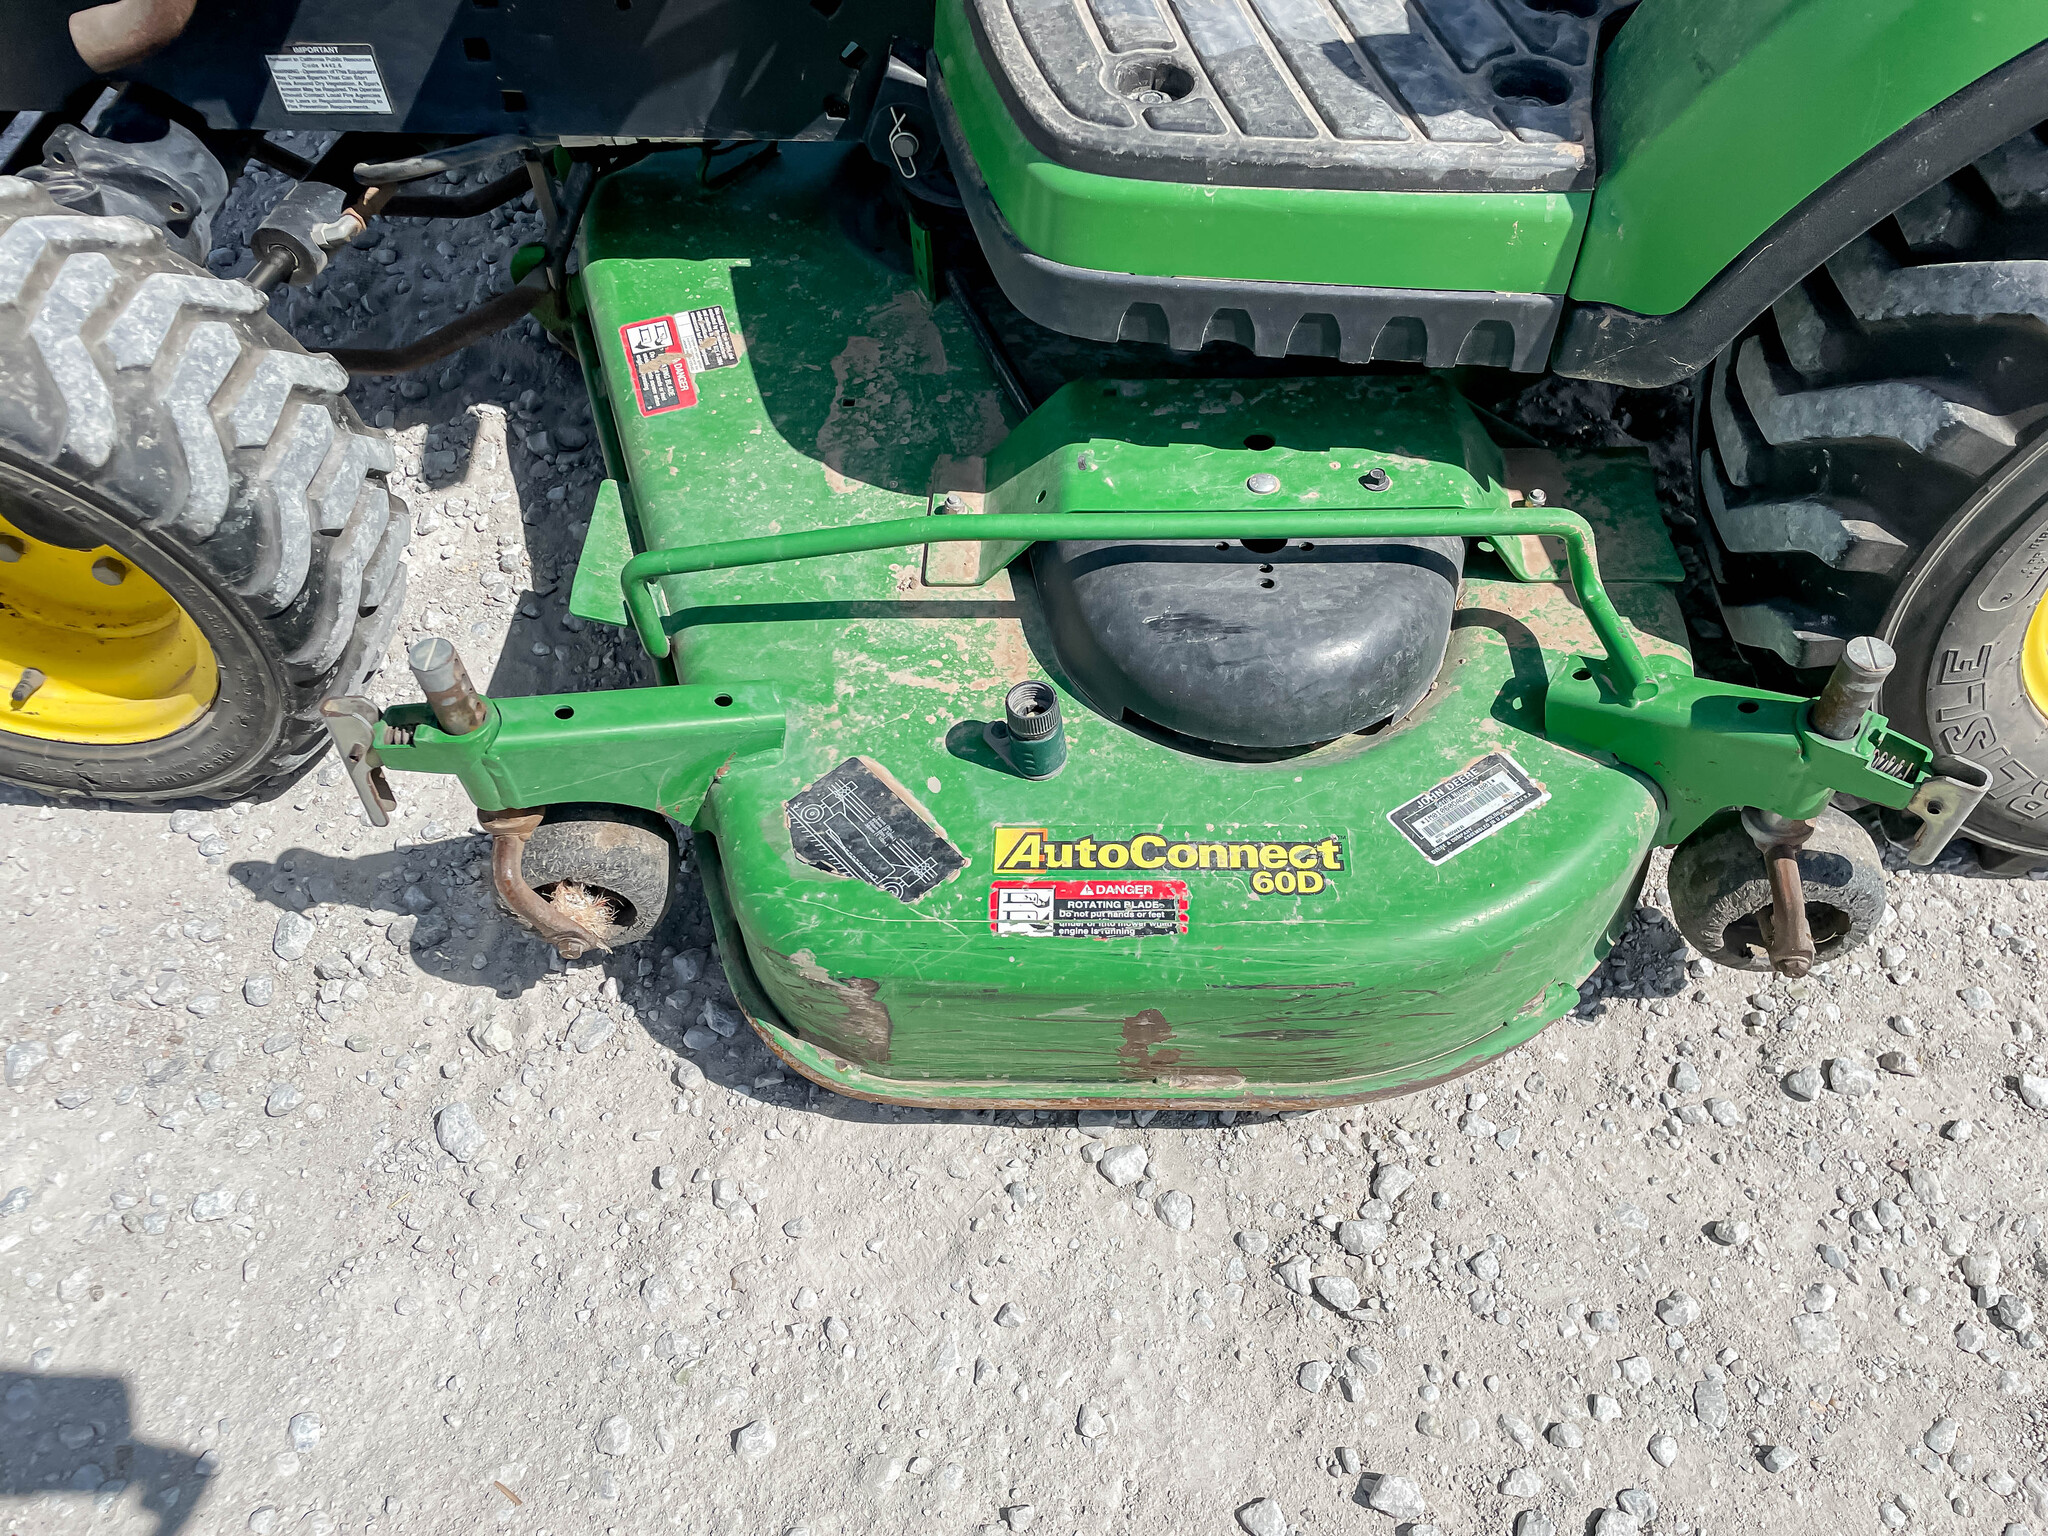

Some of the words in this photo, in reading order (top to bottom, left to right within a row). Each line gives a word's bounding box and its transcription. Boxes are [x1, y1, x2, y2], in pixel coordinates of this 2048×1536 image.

[292, 46, 339, 54] IMPORTANT
[673, 362, 689, 391] DANGER
[663, 378, 676, 397] BLADE
[1416, 788, 1445, 808] JOHN
[1443, 768, 1480, 791] DEERE
[1001, 833, 1341, 869] AutoConnect
[1096, 884, 1153, 895] DANGER
[1252, 870, 1324, 894] 60D
[1067, 900, 1121, 909] ROTATING
[1074, 910, 1089, 918] not
[1090, 910, 1107, 919] put
[1108, 909, 1135, 918] hands
[1148, 910, 1165, 918] feet
[1059, 927, 1088, 937] engine
[1091, 927, 1099, 935] is
[1100, 927, 1135, 938] running
